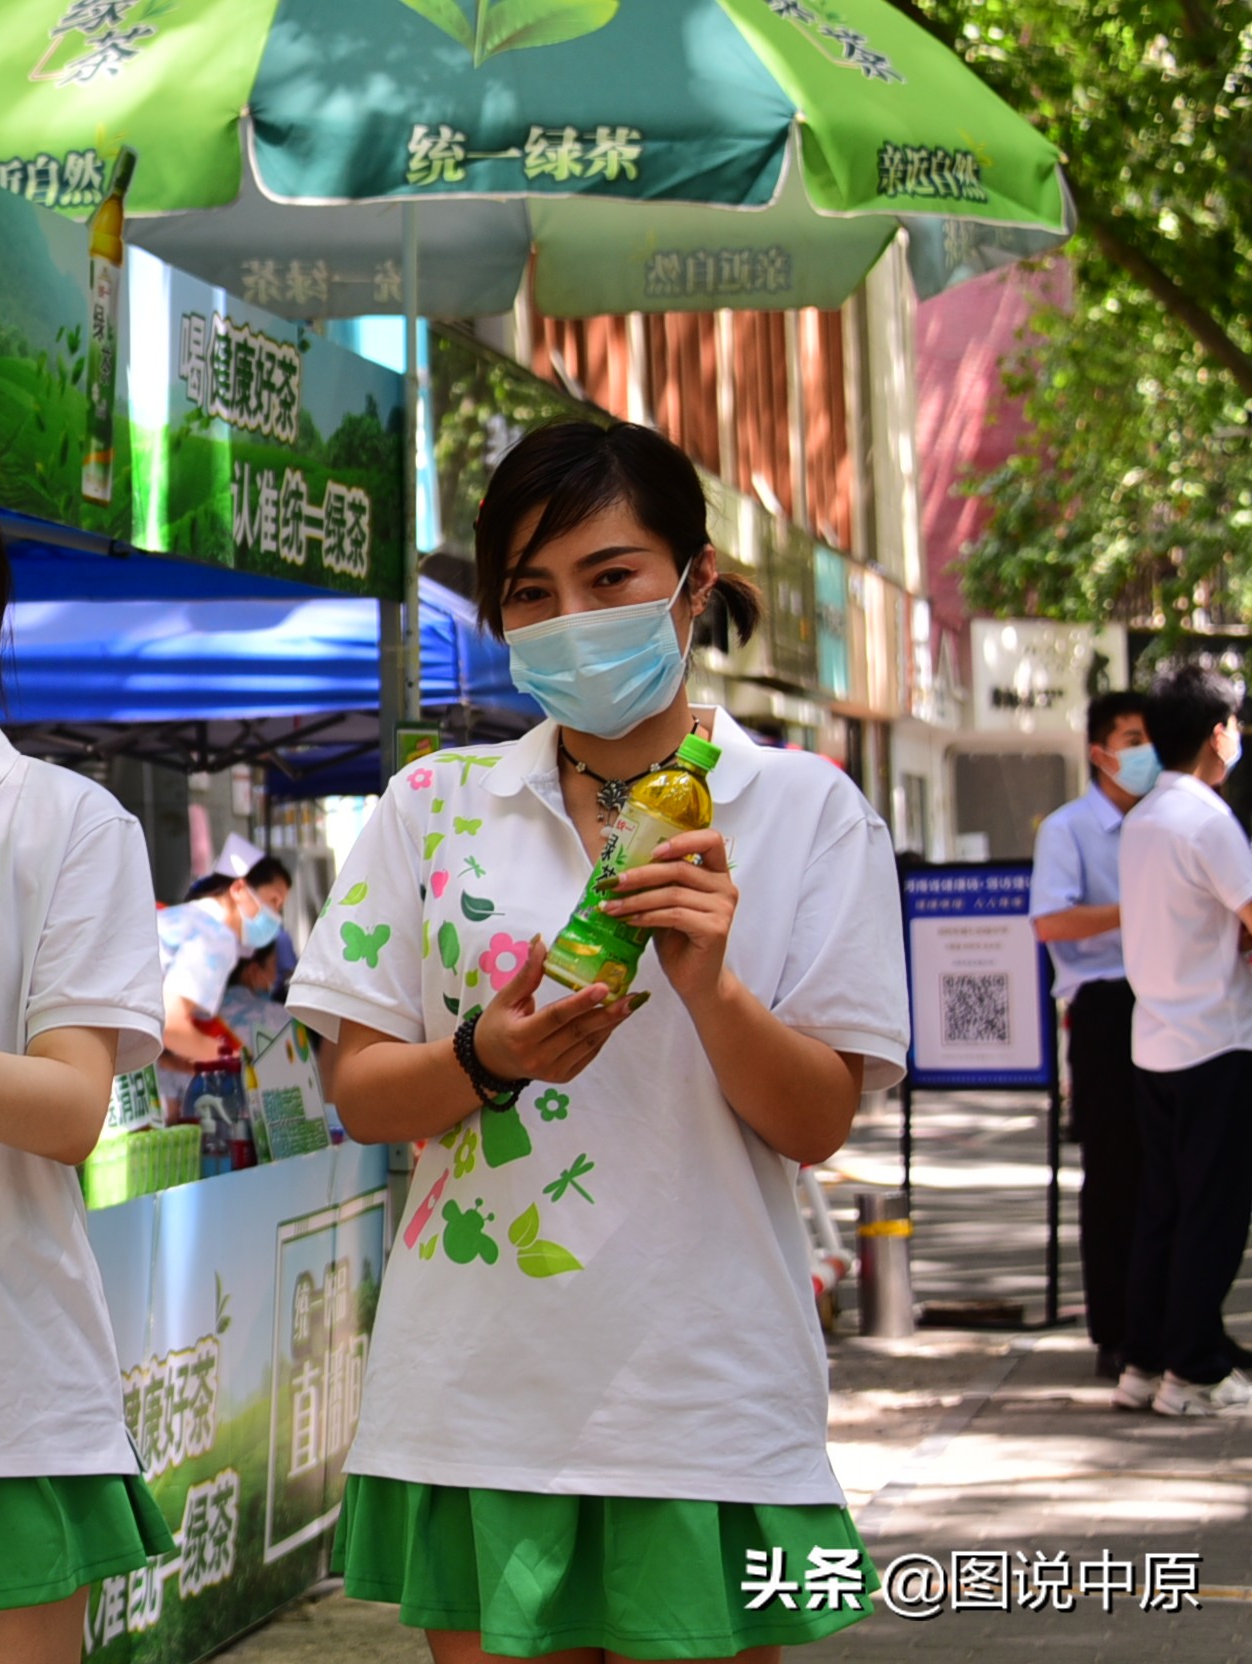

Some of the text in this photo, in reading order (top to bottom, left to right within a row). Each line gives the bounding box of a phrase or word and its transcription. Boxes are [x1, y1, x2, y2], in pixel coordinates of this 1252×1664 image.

[403, 124, 642, 187] 统一绿茶
[878, 142, 988, 204] 亲近自然
[180, 310, 299, 443] 喝健康好茶
[230, 460, 369, 578] 认准统一绿茶
[287, 1325, 369, 1478] 直播间
[83, 1466, 240, 1656] 准统一绿茶
